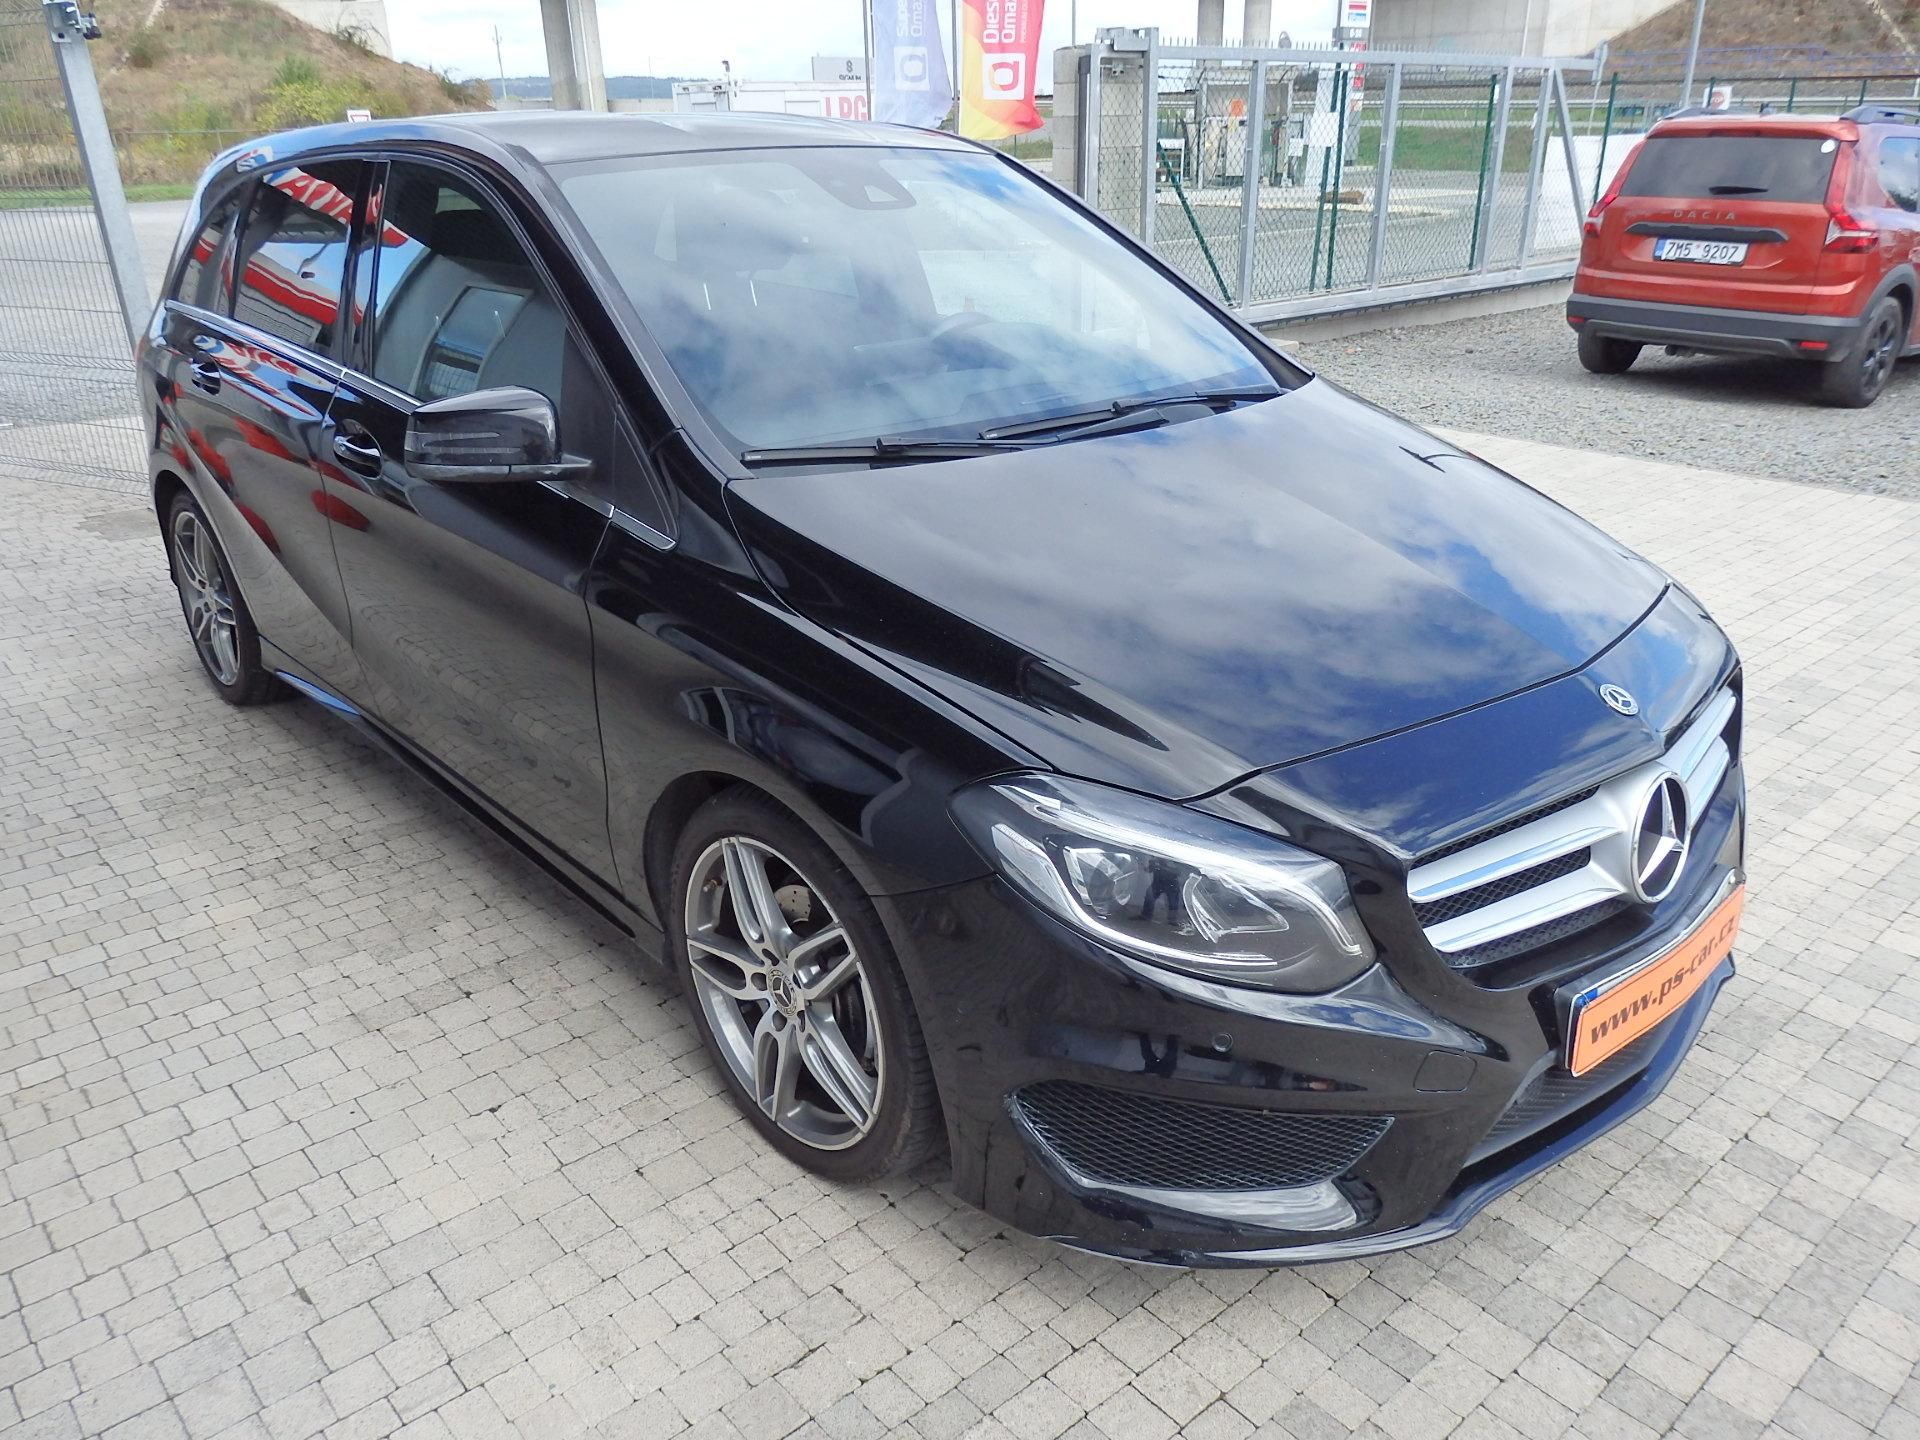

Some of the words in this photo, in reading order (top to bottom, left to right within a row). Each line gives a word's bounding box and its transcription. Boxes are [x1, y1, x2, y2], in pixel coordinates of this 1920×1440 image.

[910, 0, 922, 37] Qma
[983, 0, 1000, 43] Dies
[1001, 0, 1016, 43] Qma
[1673, 209, 1735, 220] DACIA
[1665, 242, 1692, 257] 7M5
[1702, 244, 1739, 260] 9207
[1591, 915, 1735, 1045] www.ps-car.cz
